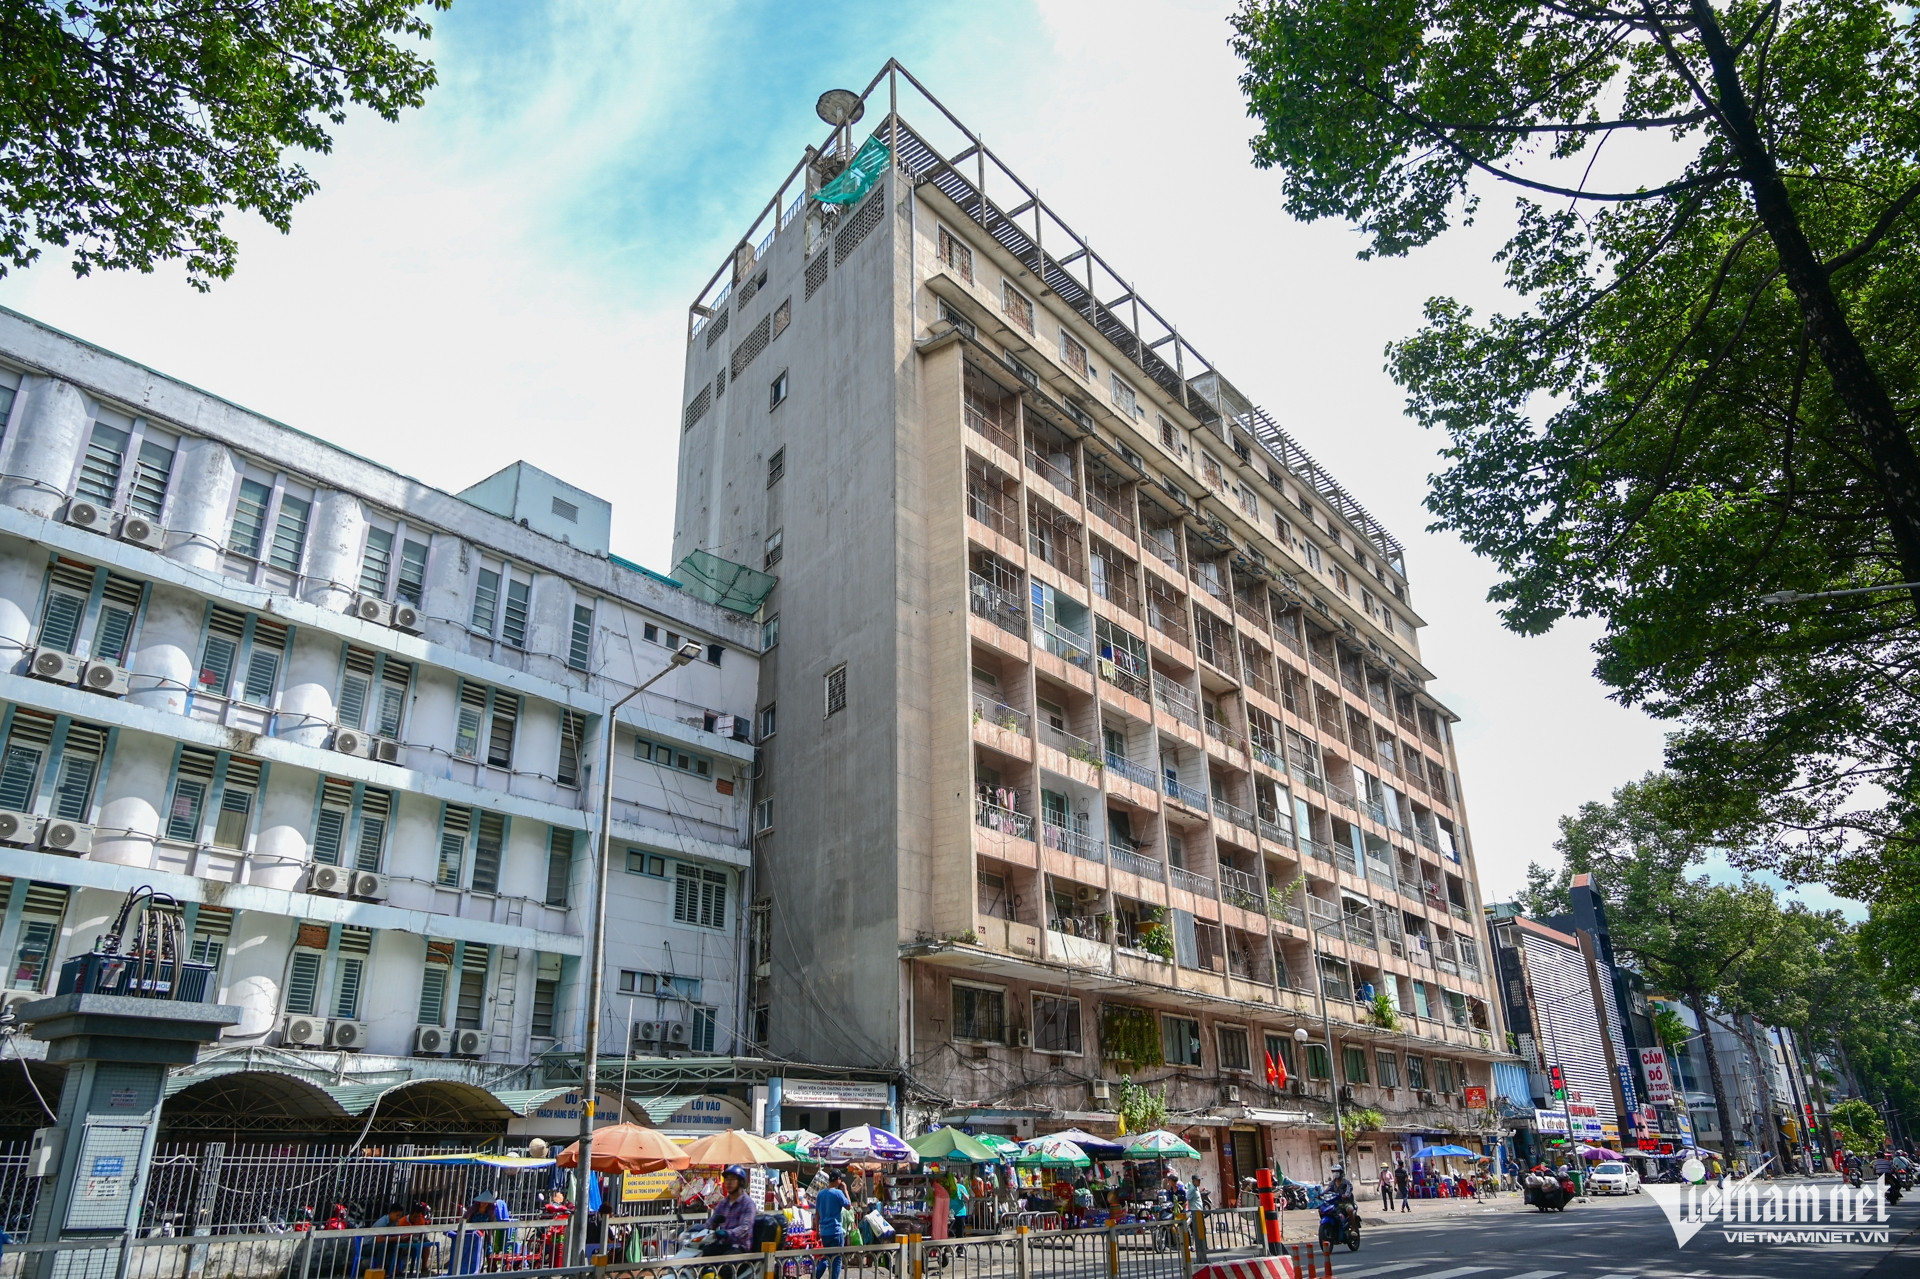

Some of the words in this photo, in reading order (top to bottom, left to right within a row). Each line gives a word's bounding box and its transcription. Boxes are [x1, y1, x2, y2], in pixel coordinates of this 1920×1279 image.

[1642, 1050, 1663, 1064] CẦM
[1649, 1066, 1662, 1080] ĐỒ
[692, 1098, 704, 1110] LỐI
[706, 1100, 721, 1111] VÀO
[537, 1109, 552, 1118] KHÁCH
[554, 1109, 567, 1119] HÀNG
[568, 1109, 578, 1119] ĐẾN
[606, 1111, 619, 1122] BỆNH
